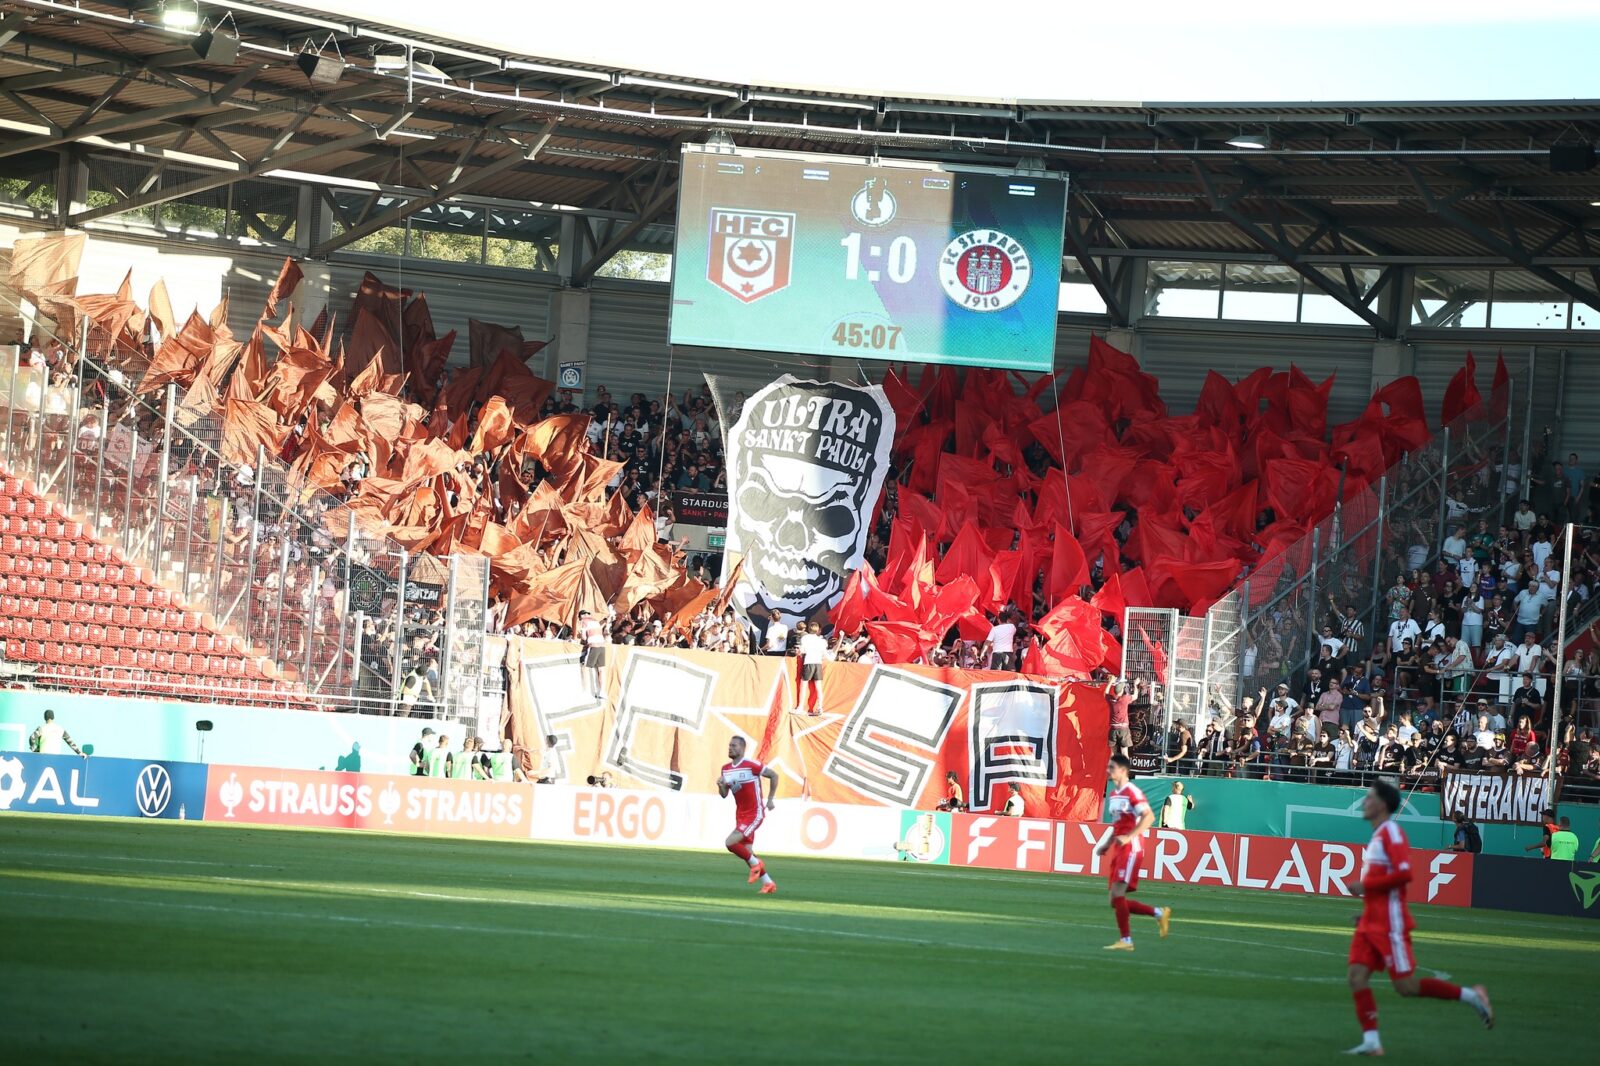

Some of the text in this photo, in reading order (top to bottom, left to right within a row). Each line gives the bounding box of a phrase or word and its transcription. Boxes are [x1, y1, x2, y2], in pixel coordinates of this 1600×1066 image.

[718, 214, 785, 237] HFC
[840, 232, 917, 284] 1:0
[943, 232, 1027, 271] FC ST. PAULI
[964, 294, 1000, 308] 1910
[832, 322, 902, 351] 45:07
[744, 429, 872, 474] SANKT PAULI
[248, 780, 372, 817] STRAUSS
[406, 788, 523, 825] STRAUSS
[573, 792, 666, 840] ERGO
[1016, 820, 1366, 897] FLYRALAR
